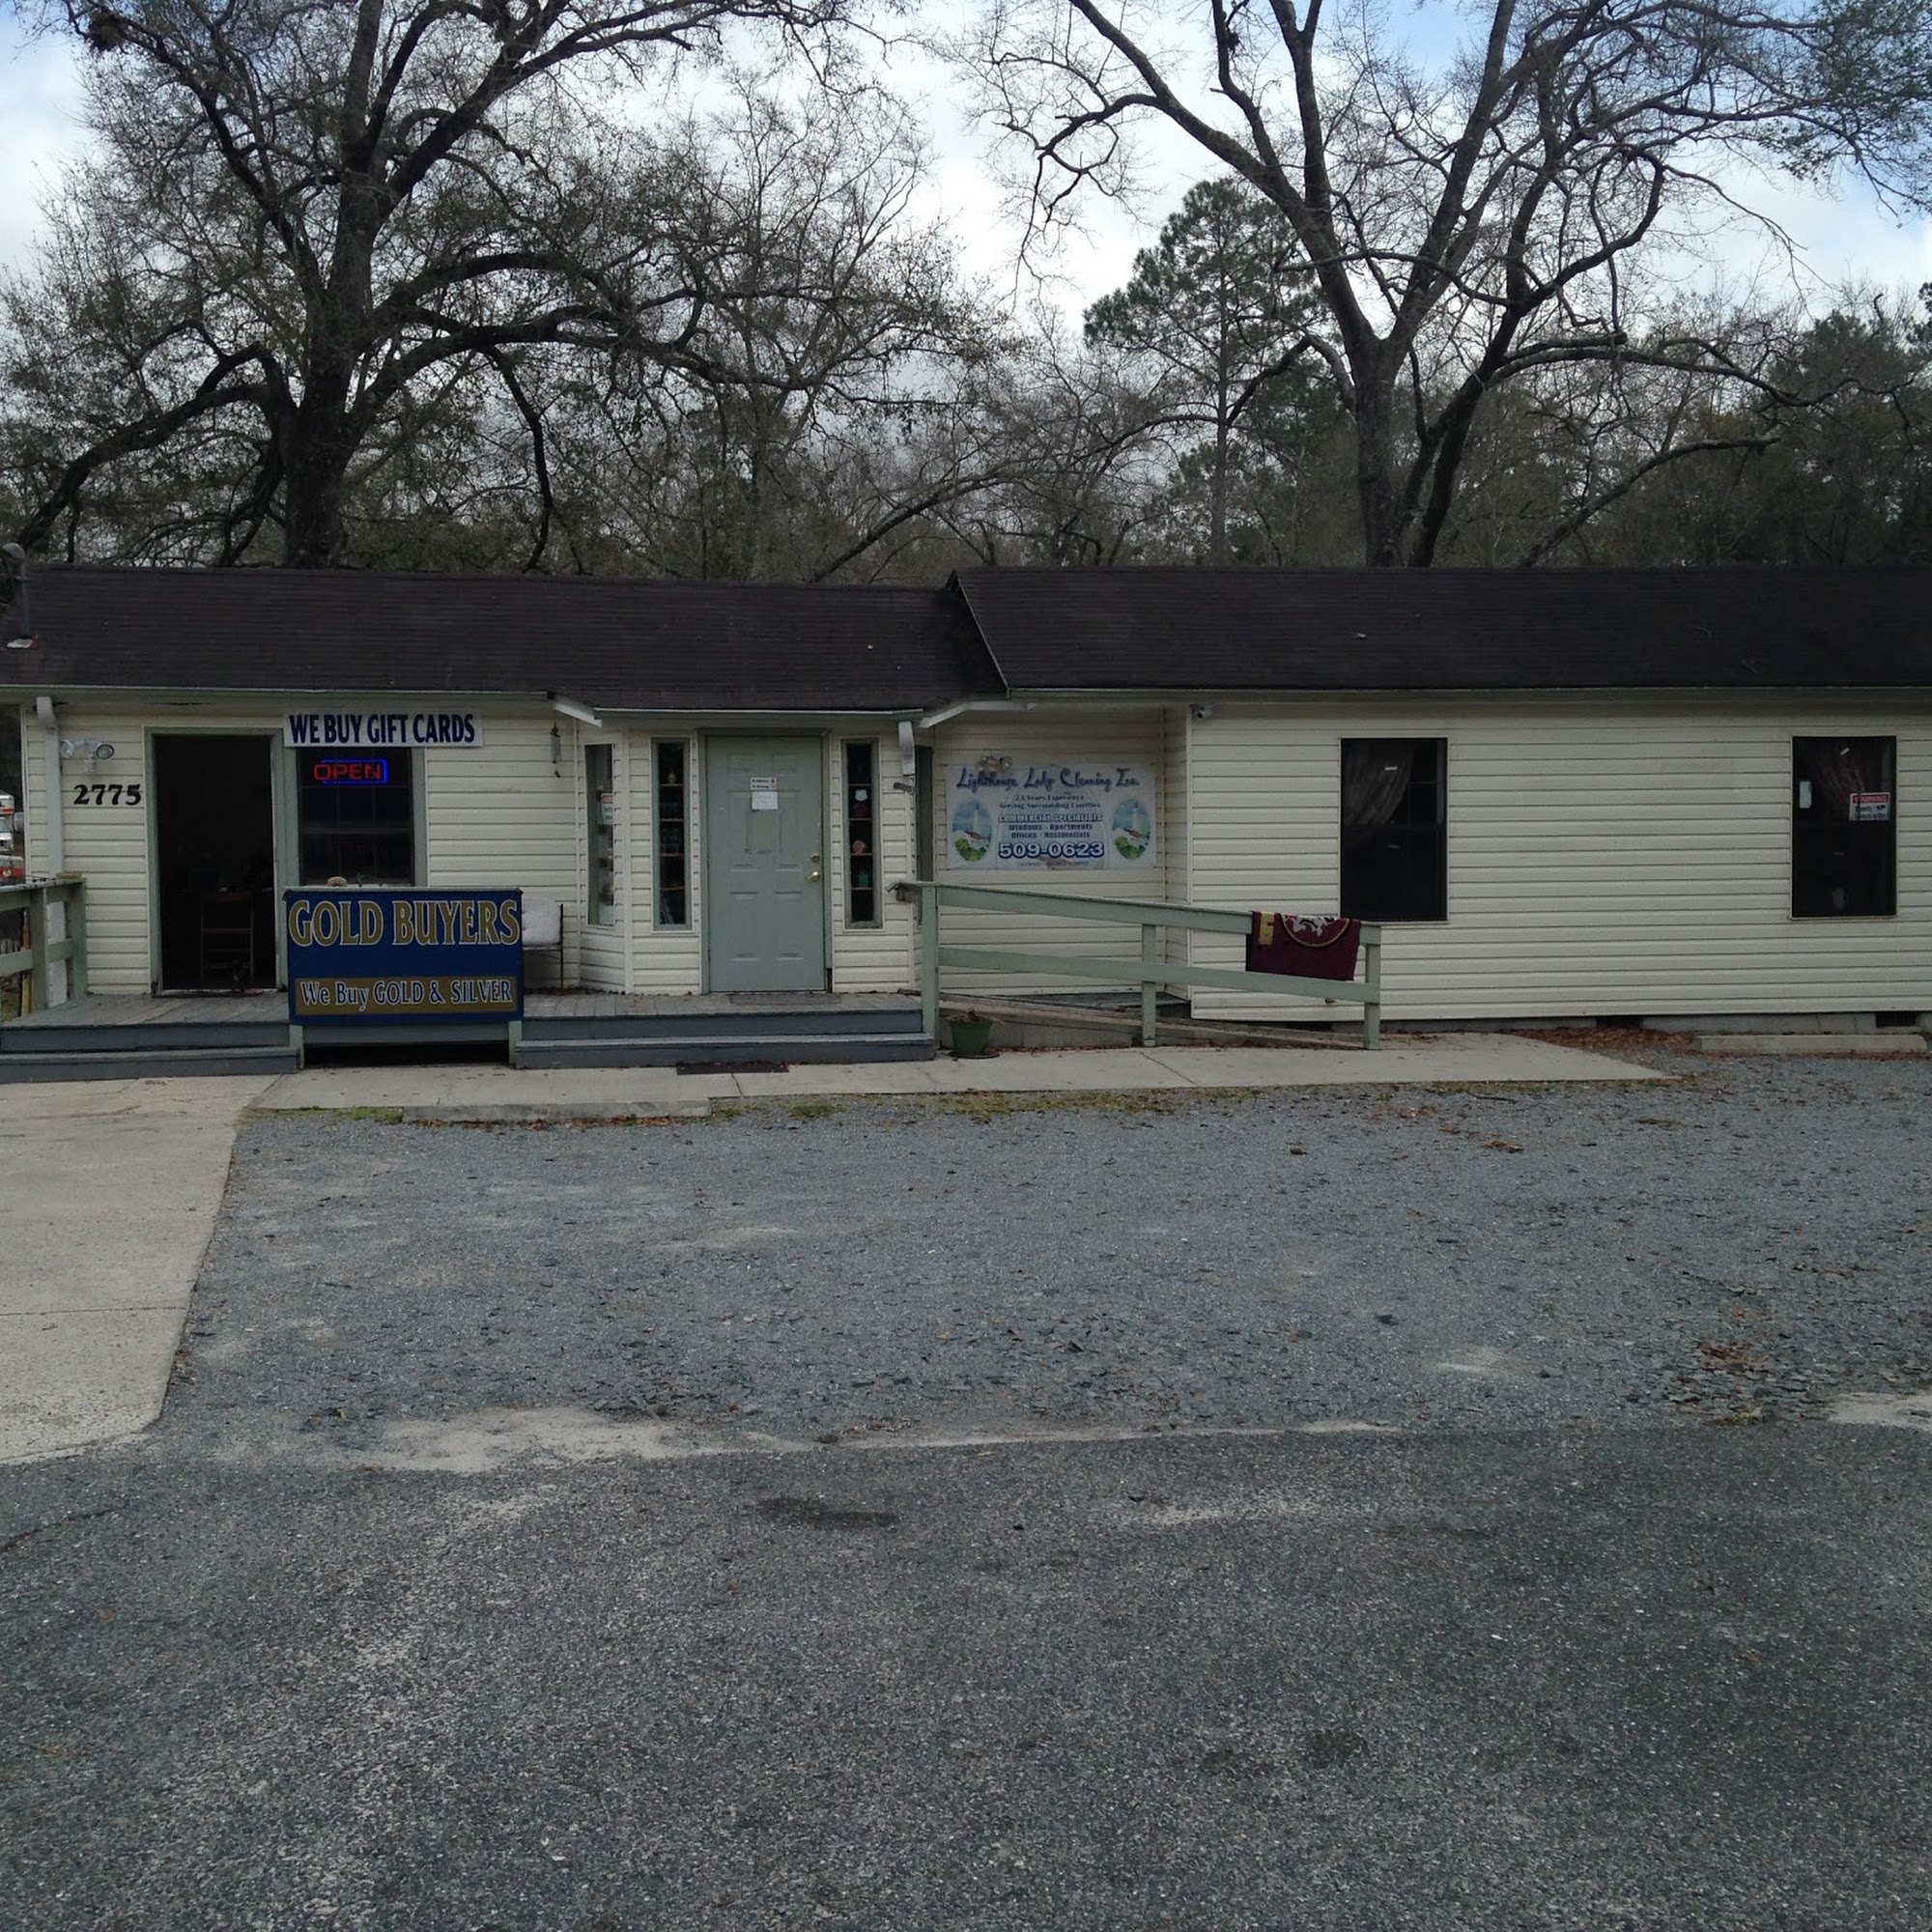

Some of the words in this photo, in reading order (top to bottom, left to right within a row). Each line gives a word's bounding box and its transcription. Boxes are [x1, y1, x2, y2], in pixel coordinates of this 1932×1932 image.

[290, 715, 321, 743] WE
[324, 715, 362, 743] BUY
[366, 715, 409, 743] GIFT
[412, 714, 475, 743] CARDS
[314, 763, 382, 781] OPEN
[1024, 767, 1053, 791] Lady
[1061, 767, 1111, 792] Cleaning
[73, 783, 141, 805] 2775
[998, 841, 1104, 859] 509-0623
[289, 899, 384, 947] GOLD
[391, 899, 521, 946] BUYERS
[301, 981, 330, 1006] We
[335, 981, 370, 1011] Buy
[374, 981, 423, 1005] GOLD
[429, 980, 446, 1005] &
[450, 980, 513, 1004] SILVER
